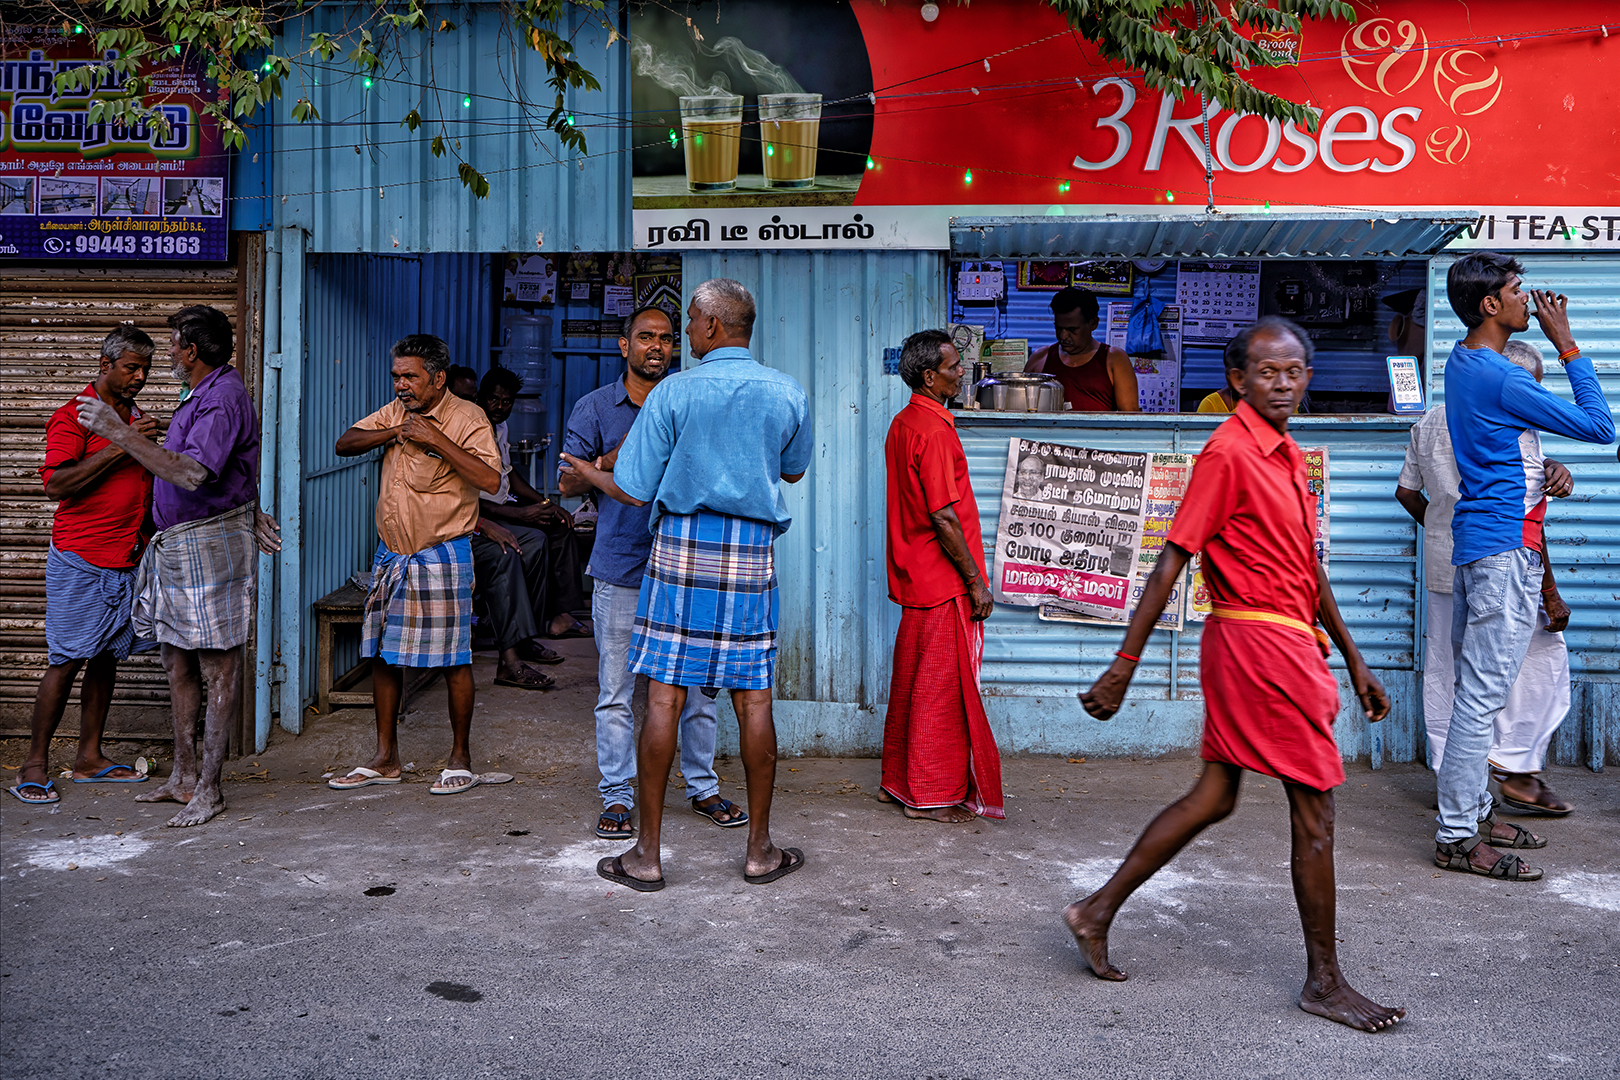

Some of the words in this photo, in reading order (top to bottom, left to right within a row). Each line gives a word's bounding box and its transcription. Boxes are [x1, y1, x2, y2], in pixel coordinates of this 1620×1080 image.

[1258, 38, 1297, 49] Brooke
[1271, 49, 1292, 58] ond
[1072, 77, 1136, 172] 3
[1143, 79, 1423, 174] Roses
[648, 219, 710, 248] ரவி
[721, 224, 748, 241] டீ
[758, 213, 875, 241] ஸ்டால்
[1457, 215, 1495, 240] VI
[1507, 215, 1571, 241] TEA
[75, 235, 136, 253] 99443
[141, 236, 200, 254] 31363
[1045, 464, 1096, 483] ராமதாஸ்
[1100, 470, 1144, 488] முடிவில்
[1042, 483, 1069, 500] திடீர்
[1073, 488, 1141, 511] தடுமாற்றம்
[1010, 504, 1057, 521] சமையல்
[1061, 509, 1100, 527] கியாஸ்
[1105, 514, 1138, 532] விலை
[1060, 529, 1114, 551] குறைப்பு
[1005, 540, 1052, 565] மோடி
[1059, 549, 1109, 573] அதிரடி
[1005, 569, 1060, 588] மாலை
[1083, 580, 1125, 600] மலர்
